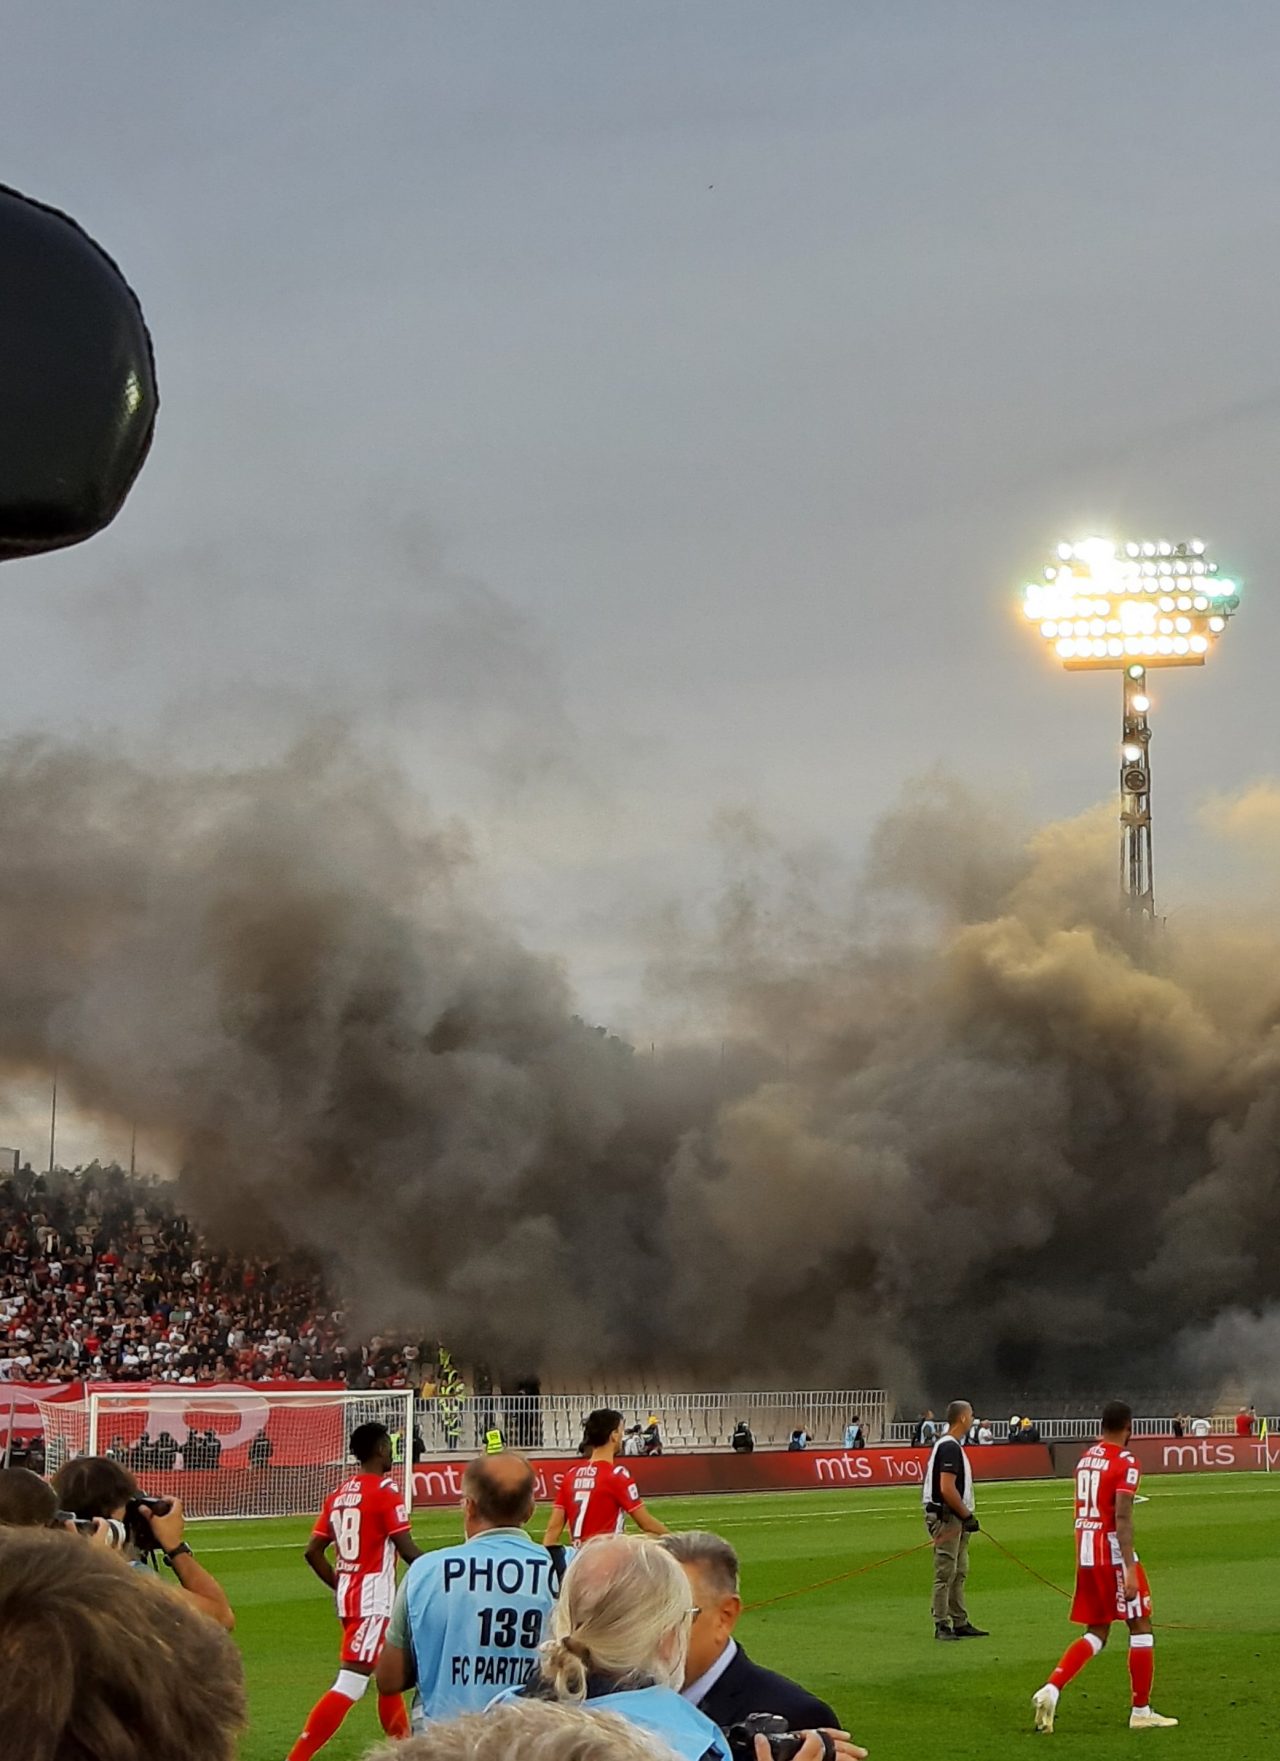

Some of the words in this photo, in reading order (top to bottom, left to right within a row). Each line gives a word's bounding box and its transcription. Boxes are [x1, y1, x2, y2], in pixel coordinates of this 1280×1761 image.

[815, 1452, 872, 1480] mts
[880, 1455, 924, 1481] Tvoj
[1163, 1440, 1235, 1466] mts
[412, 1465, 462, 1496] mt
[1077, 1469, 1101, 1518] 91
[574, 1490, 591, 1537] 7
[330, 1508, 360, 1560] 18
[477, 1607, 543, 1648] 139
[452, 1656, 470, 1686] FC
[474, 1656, 538, 1686] PARTIZ
